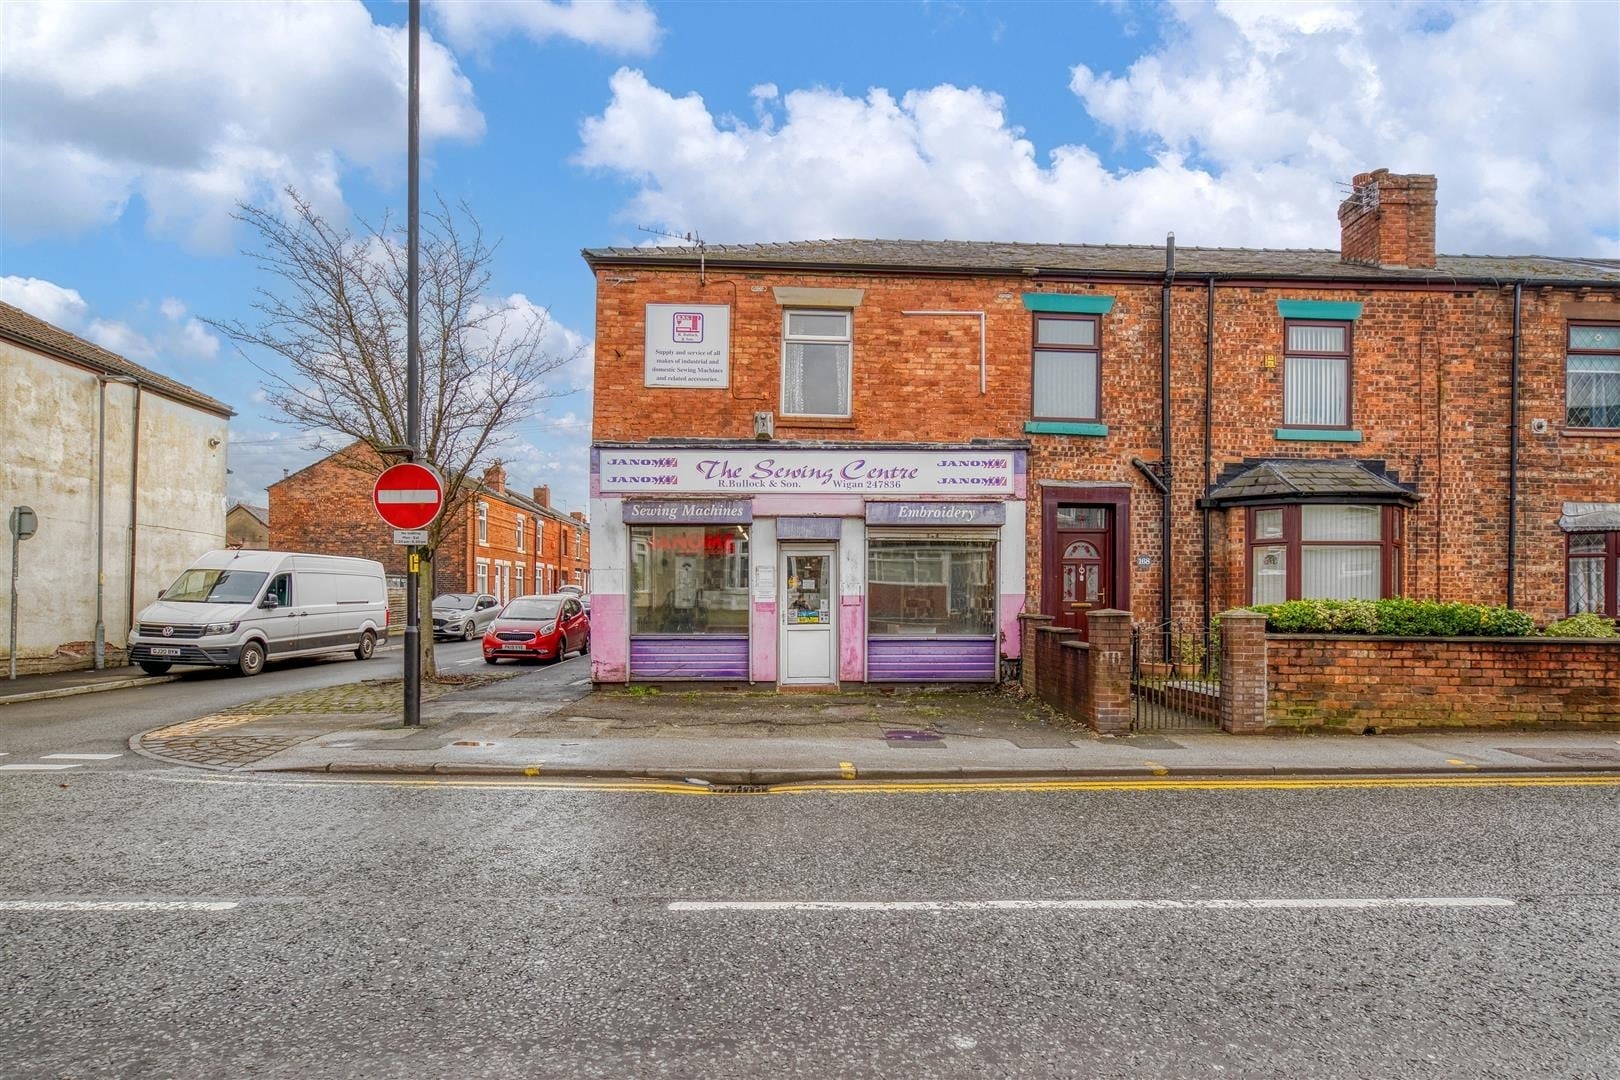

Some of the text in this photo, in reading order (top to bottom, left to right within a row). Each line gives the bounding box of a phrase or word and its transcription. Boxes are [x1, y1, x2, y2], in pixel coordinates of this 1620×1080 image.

[695, 458, 920, 485] The Sewing Centre
[718, 480, 801, 488] R.Bullock & Son.
[833, 480, 902, 489] Wigan 247836
[631, 504, 744, 519] Sewing Machines
[898, 505, 977, 521] Embroidery
